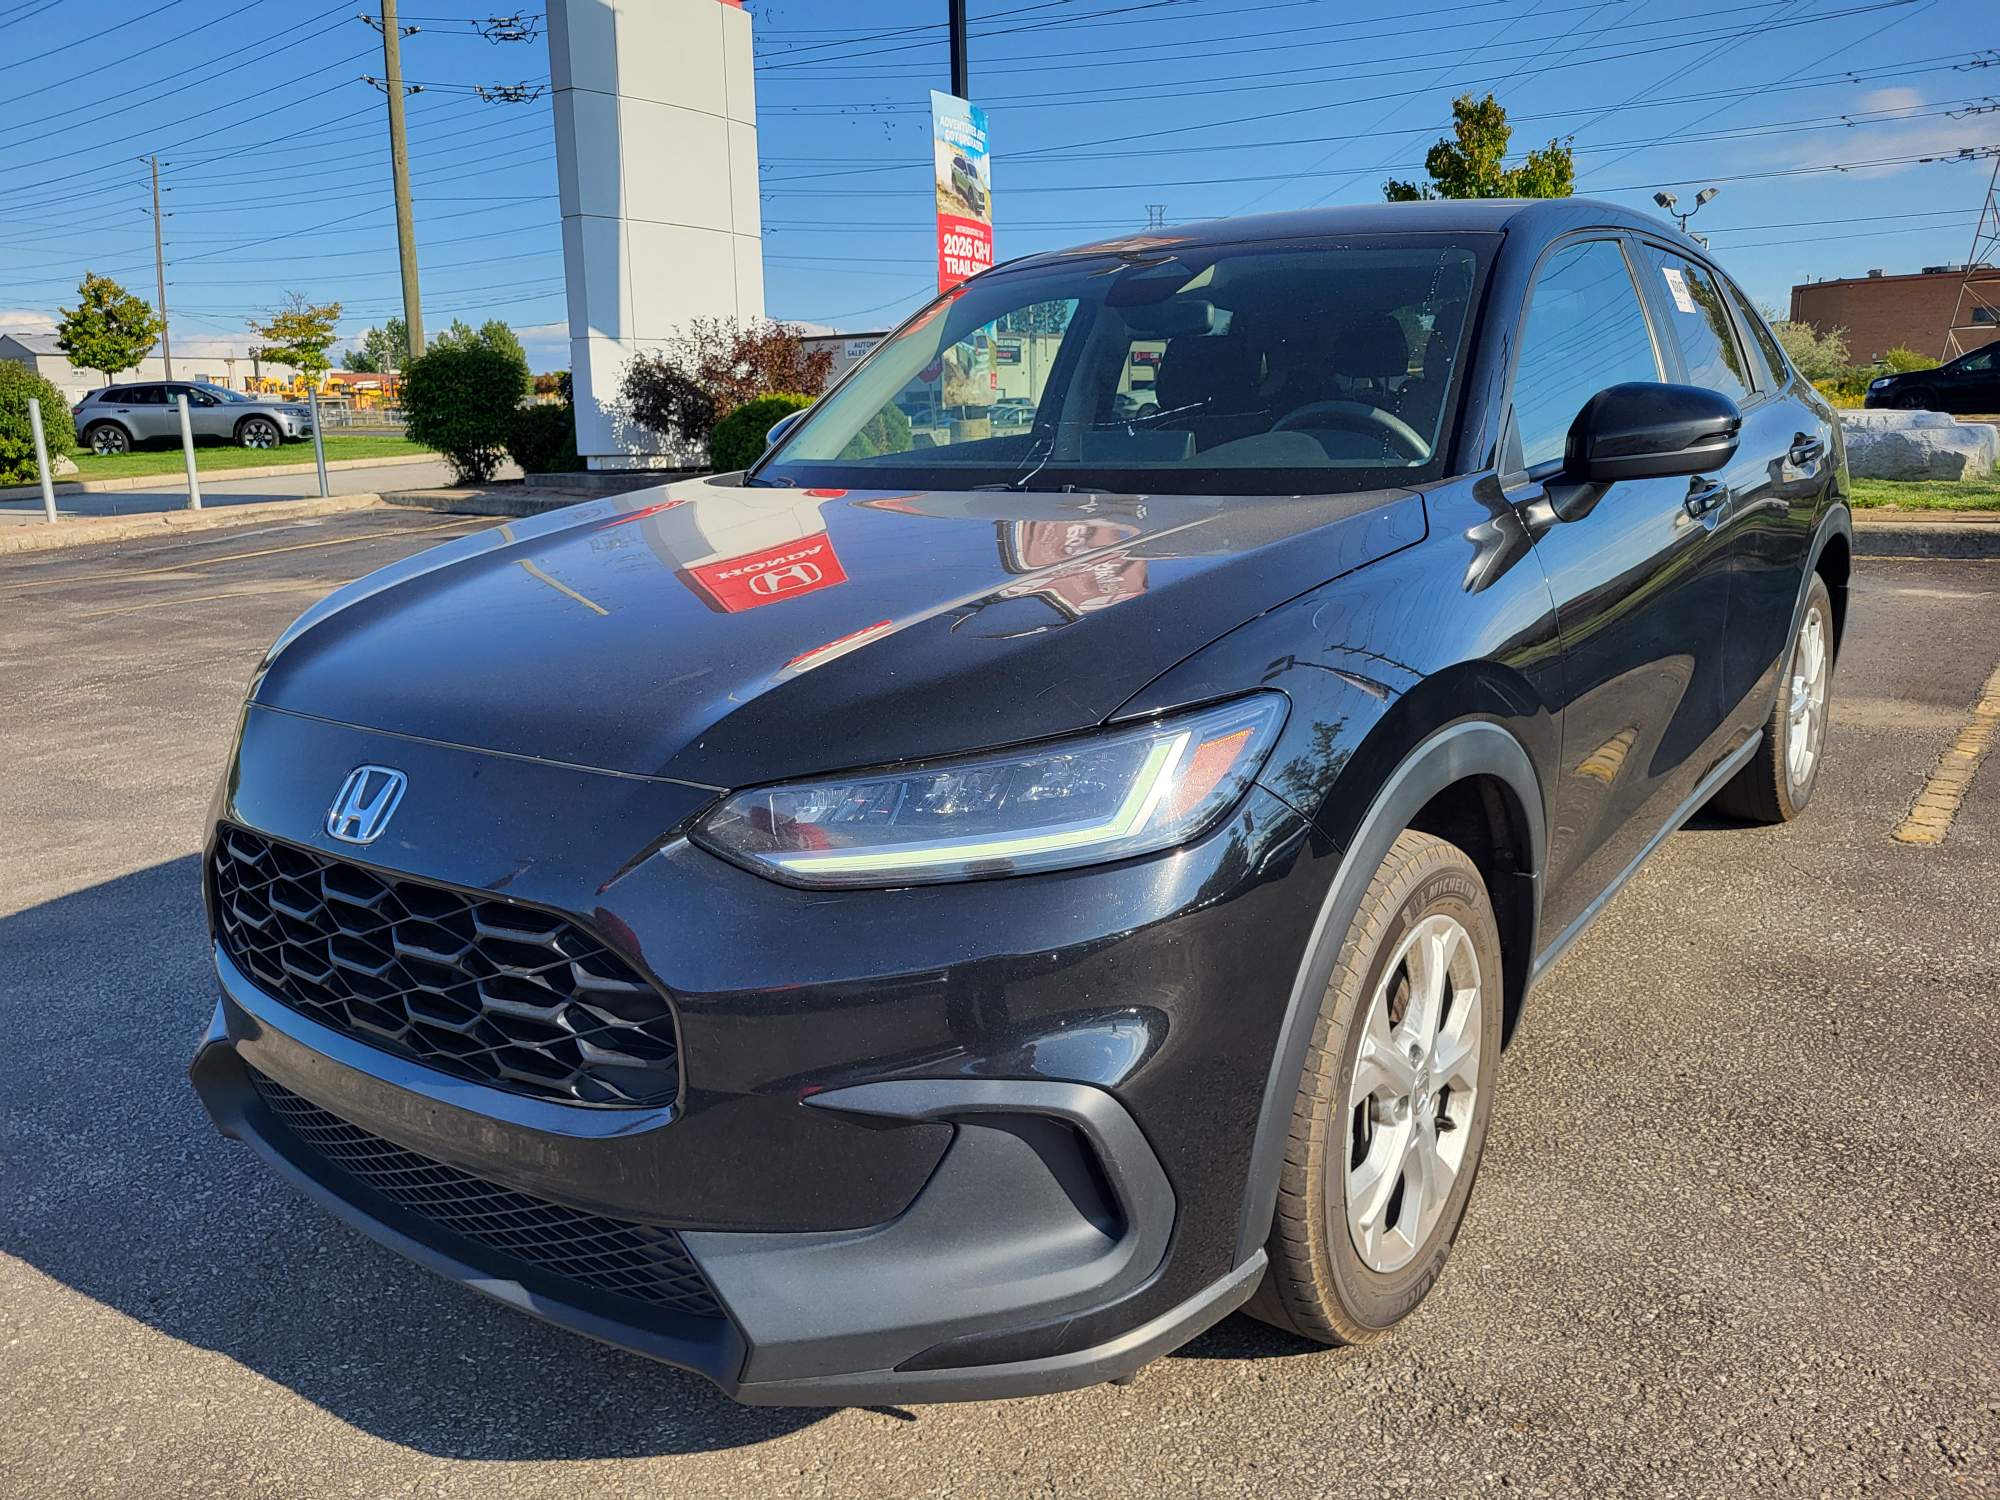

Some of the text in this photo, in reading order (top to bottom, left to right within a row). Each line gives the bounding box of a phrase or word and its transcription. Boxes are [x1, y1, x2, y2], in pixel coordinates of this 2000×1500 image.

[944, 233, 991, 263] 2026 CR-V
[1428, 877, 1477, 901] MICHELIN
